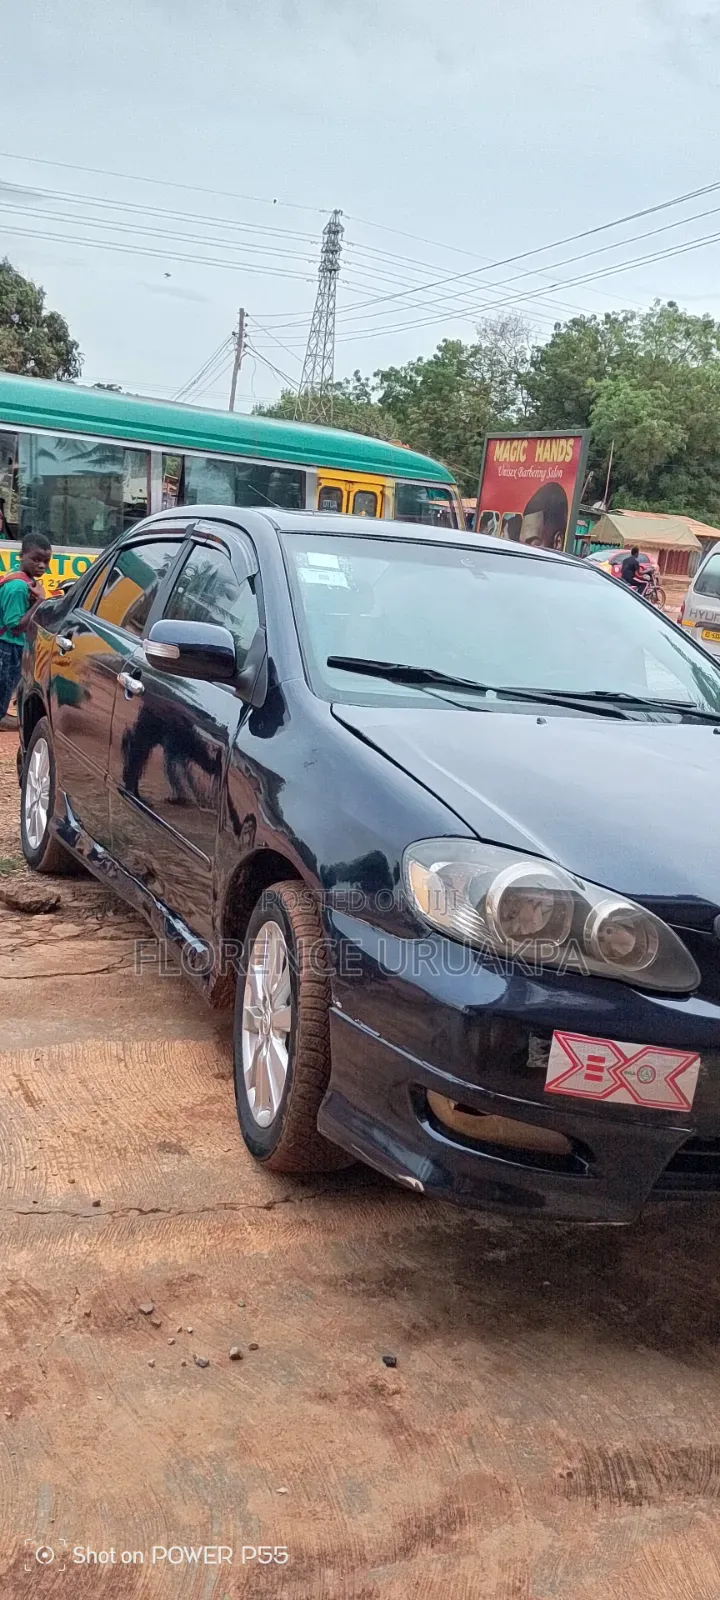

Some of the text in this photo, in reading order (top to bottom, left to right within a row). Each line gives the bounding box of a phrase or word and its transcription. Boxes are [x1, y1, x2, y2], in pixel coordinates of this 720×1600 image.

[494, 438, 574, 462] MAGIC HANDS
[498, 464, 517, 479] Unisex
[546, 465, 563, 478] Salon
